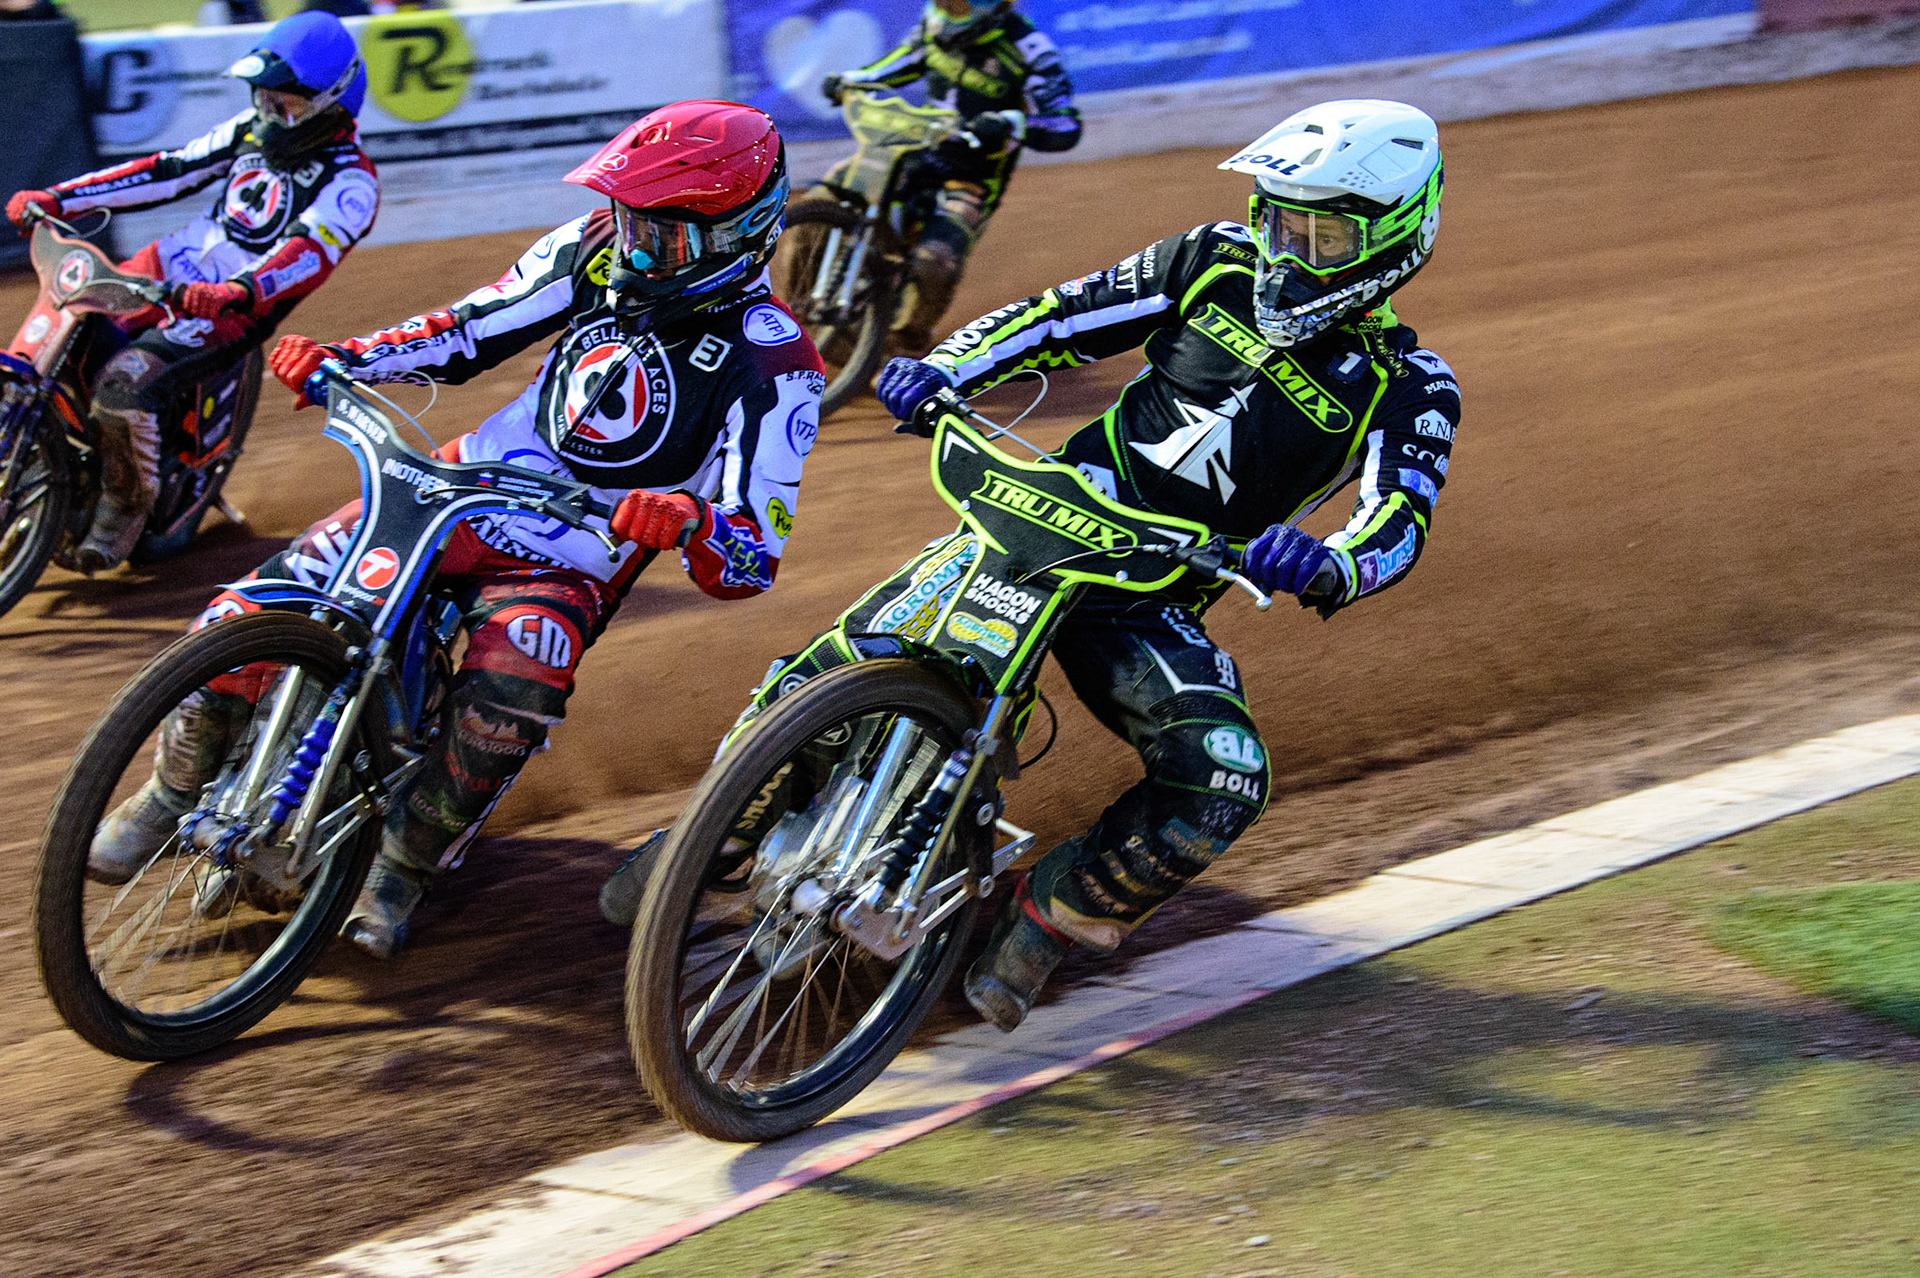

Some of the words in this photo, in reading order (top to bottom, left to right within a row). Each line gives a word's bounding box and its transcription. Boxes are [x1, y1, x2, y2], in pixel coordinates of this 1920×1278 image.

[757, 311, 788, 338] ATPI
[581, 326, 626, 350] BELLE
[646, 367, 668, 415] ACES
[1269, 360, 1342, 424] MIX
[963, 587, 1032, 625] SHOCKS
[971, 572, 1043, 615] HAGON
[1208, 769, 1261, 801] BOLL
